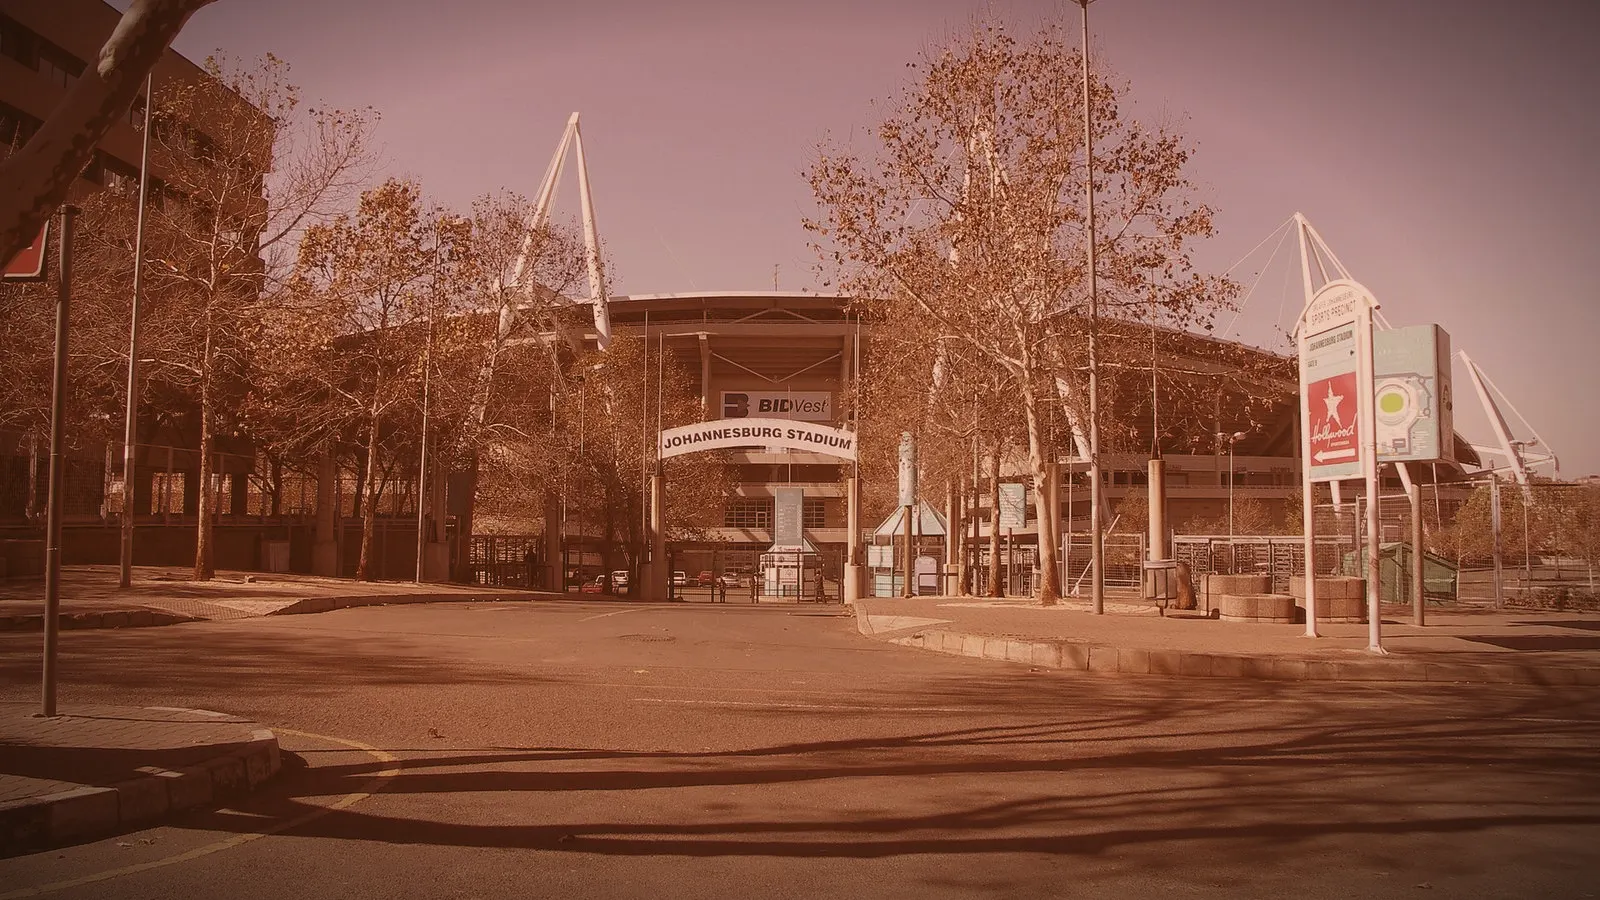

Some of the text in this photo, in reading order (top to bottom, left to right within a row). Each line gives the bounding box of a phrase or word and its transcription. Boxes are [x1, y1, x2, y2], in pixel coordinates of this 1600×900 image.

[664, 427, 852, 450] JOHANNESBURG STADIUM
[1310, 413, 1357, 449] Hollywood
